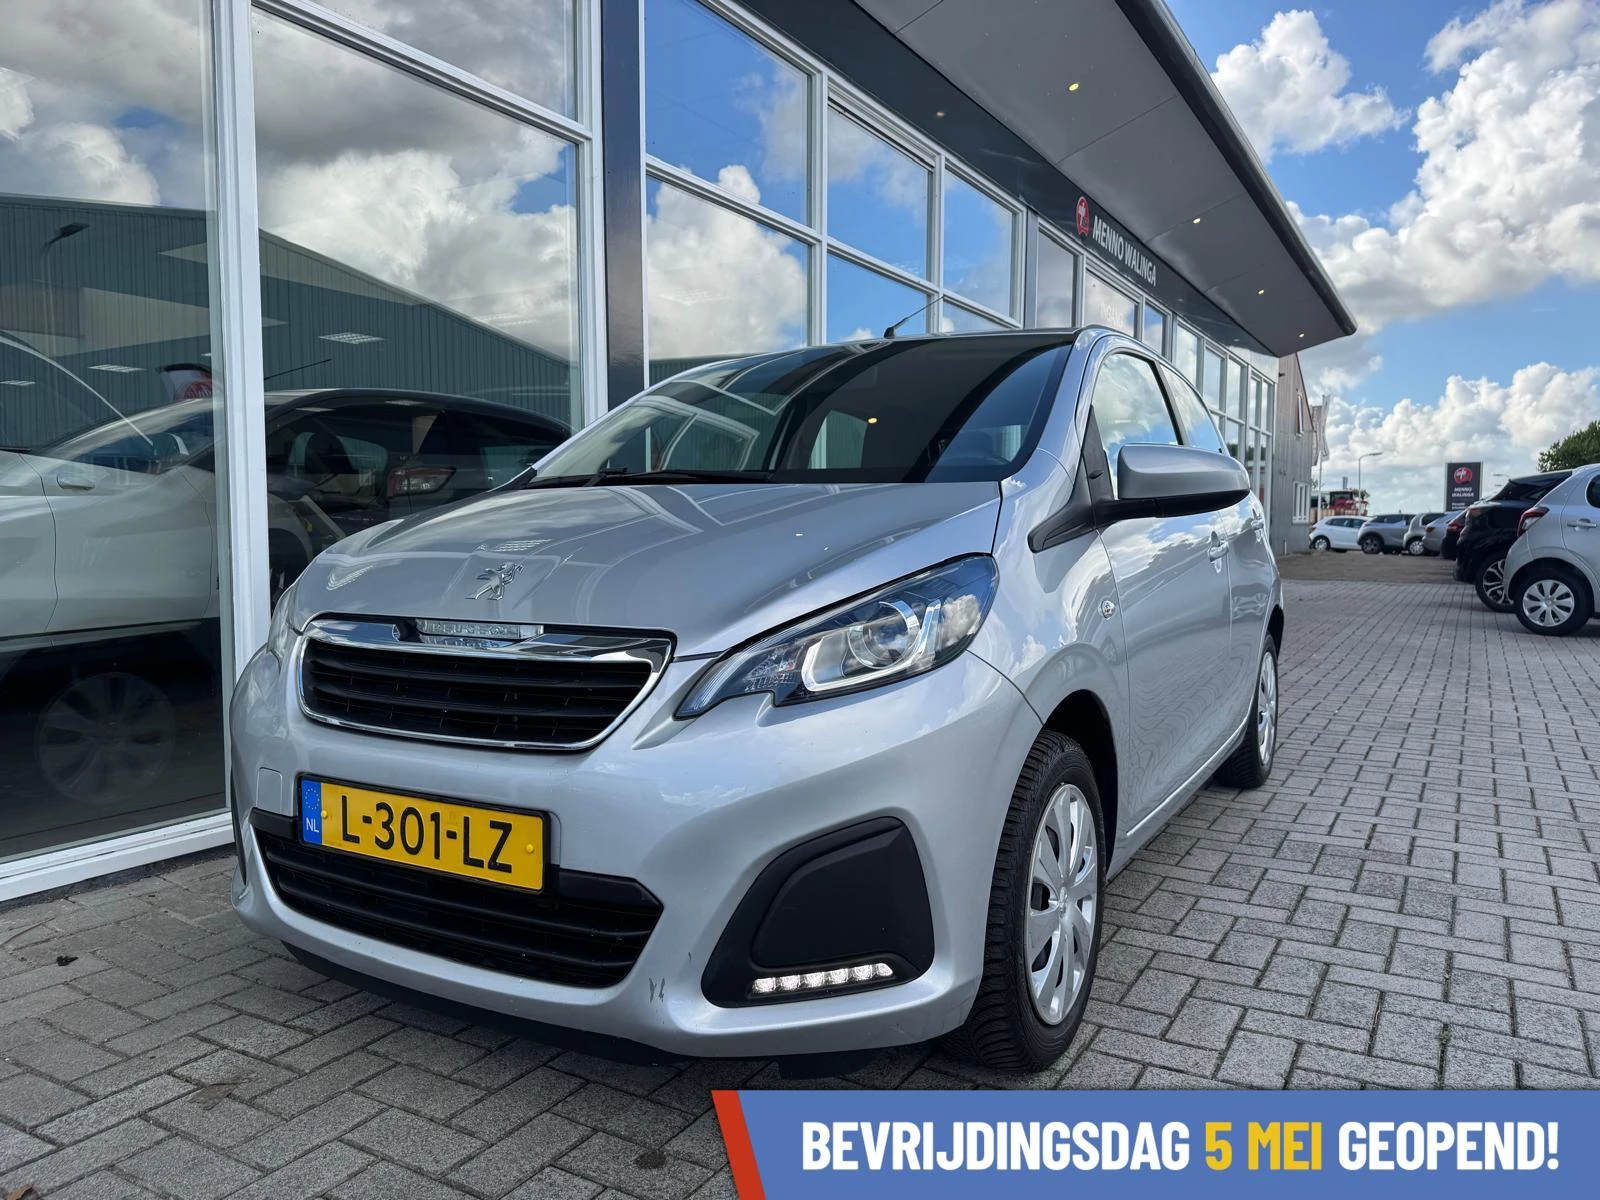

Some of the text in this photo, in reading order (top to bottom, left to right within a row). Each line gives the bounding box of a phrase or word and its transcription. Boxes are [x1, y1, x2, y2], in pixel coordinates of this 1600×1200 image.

[1092, 215, 1156, 287] MENNO WALINGA
[306, 794, 513, 874] NL L-301-LZ
